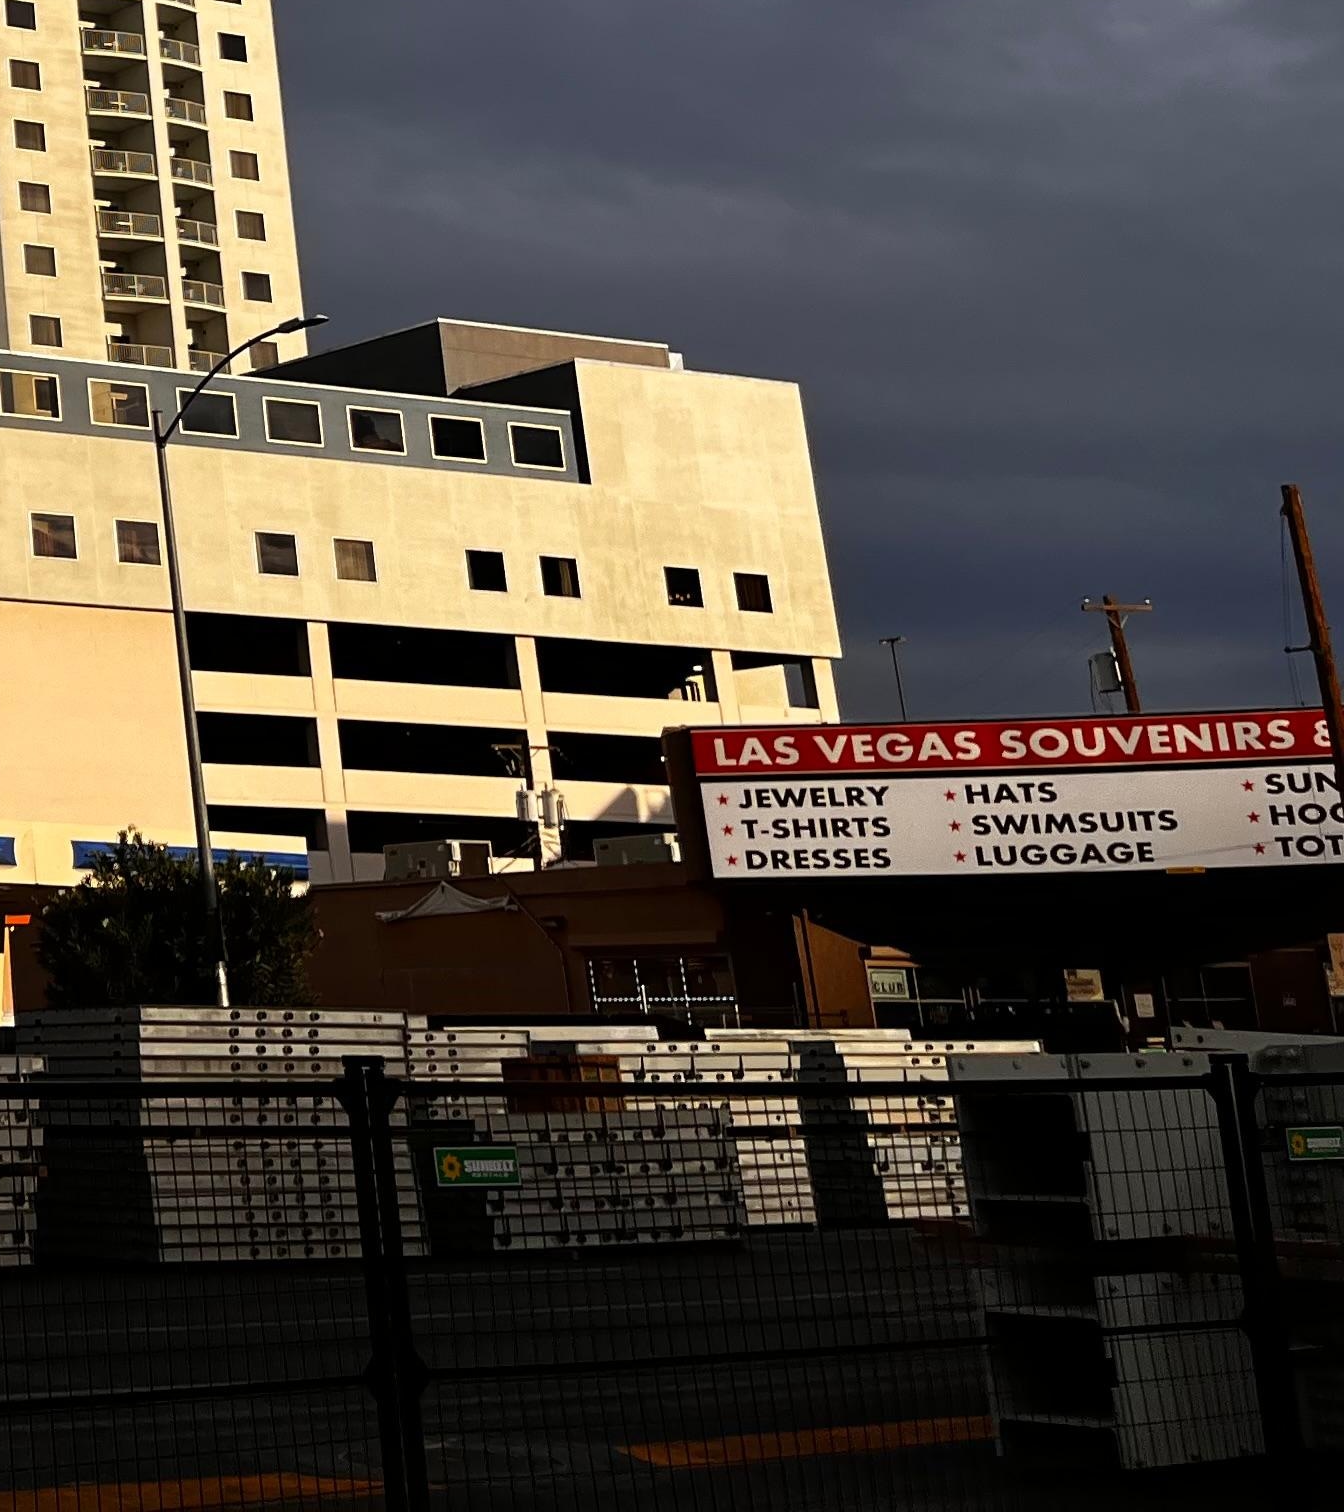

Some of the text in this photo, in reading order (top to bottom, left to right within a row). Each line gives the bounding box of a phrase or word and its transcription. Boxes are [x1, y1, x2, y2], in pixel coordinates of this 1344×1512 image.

[714, 736, 800, 767] LAS
[812, 729, 982, 764] VEGAS
[999, 718, 1296, 760] SOUVENIRS
[739, 786, 890, 809] JEWELRY
[965, 782, 1058, 804] HATS
[741, 817, 891, 839] T-SHIRTS
[972, 810, 1179, 835] SWIMSUITS
[975, 842, 1155, 866] LUGGAGE
[1274, 834, 1344, 857] TOT
[745, 848, 892, 870] DRESSES
